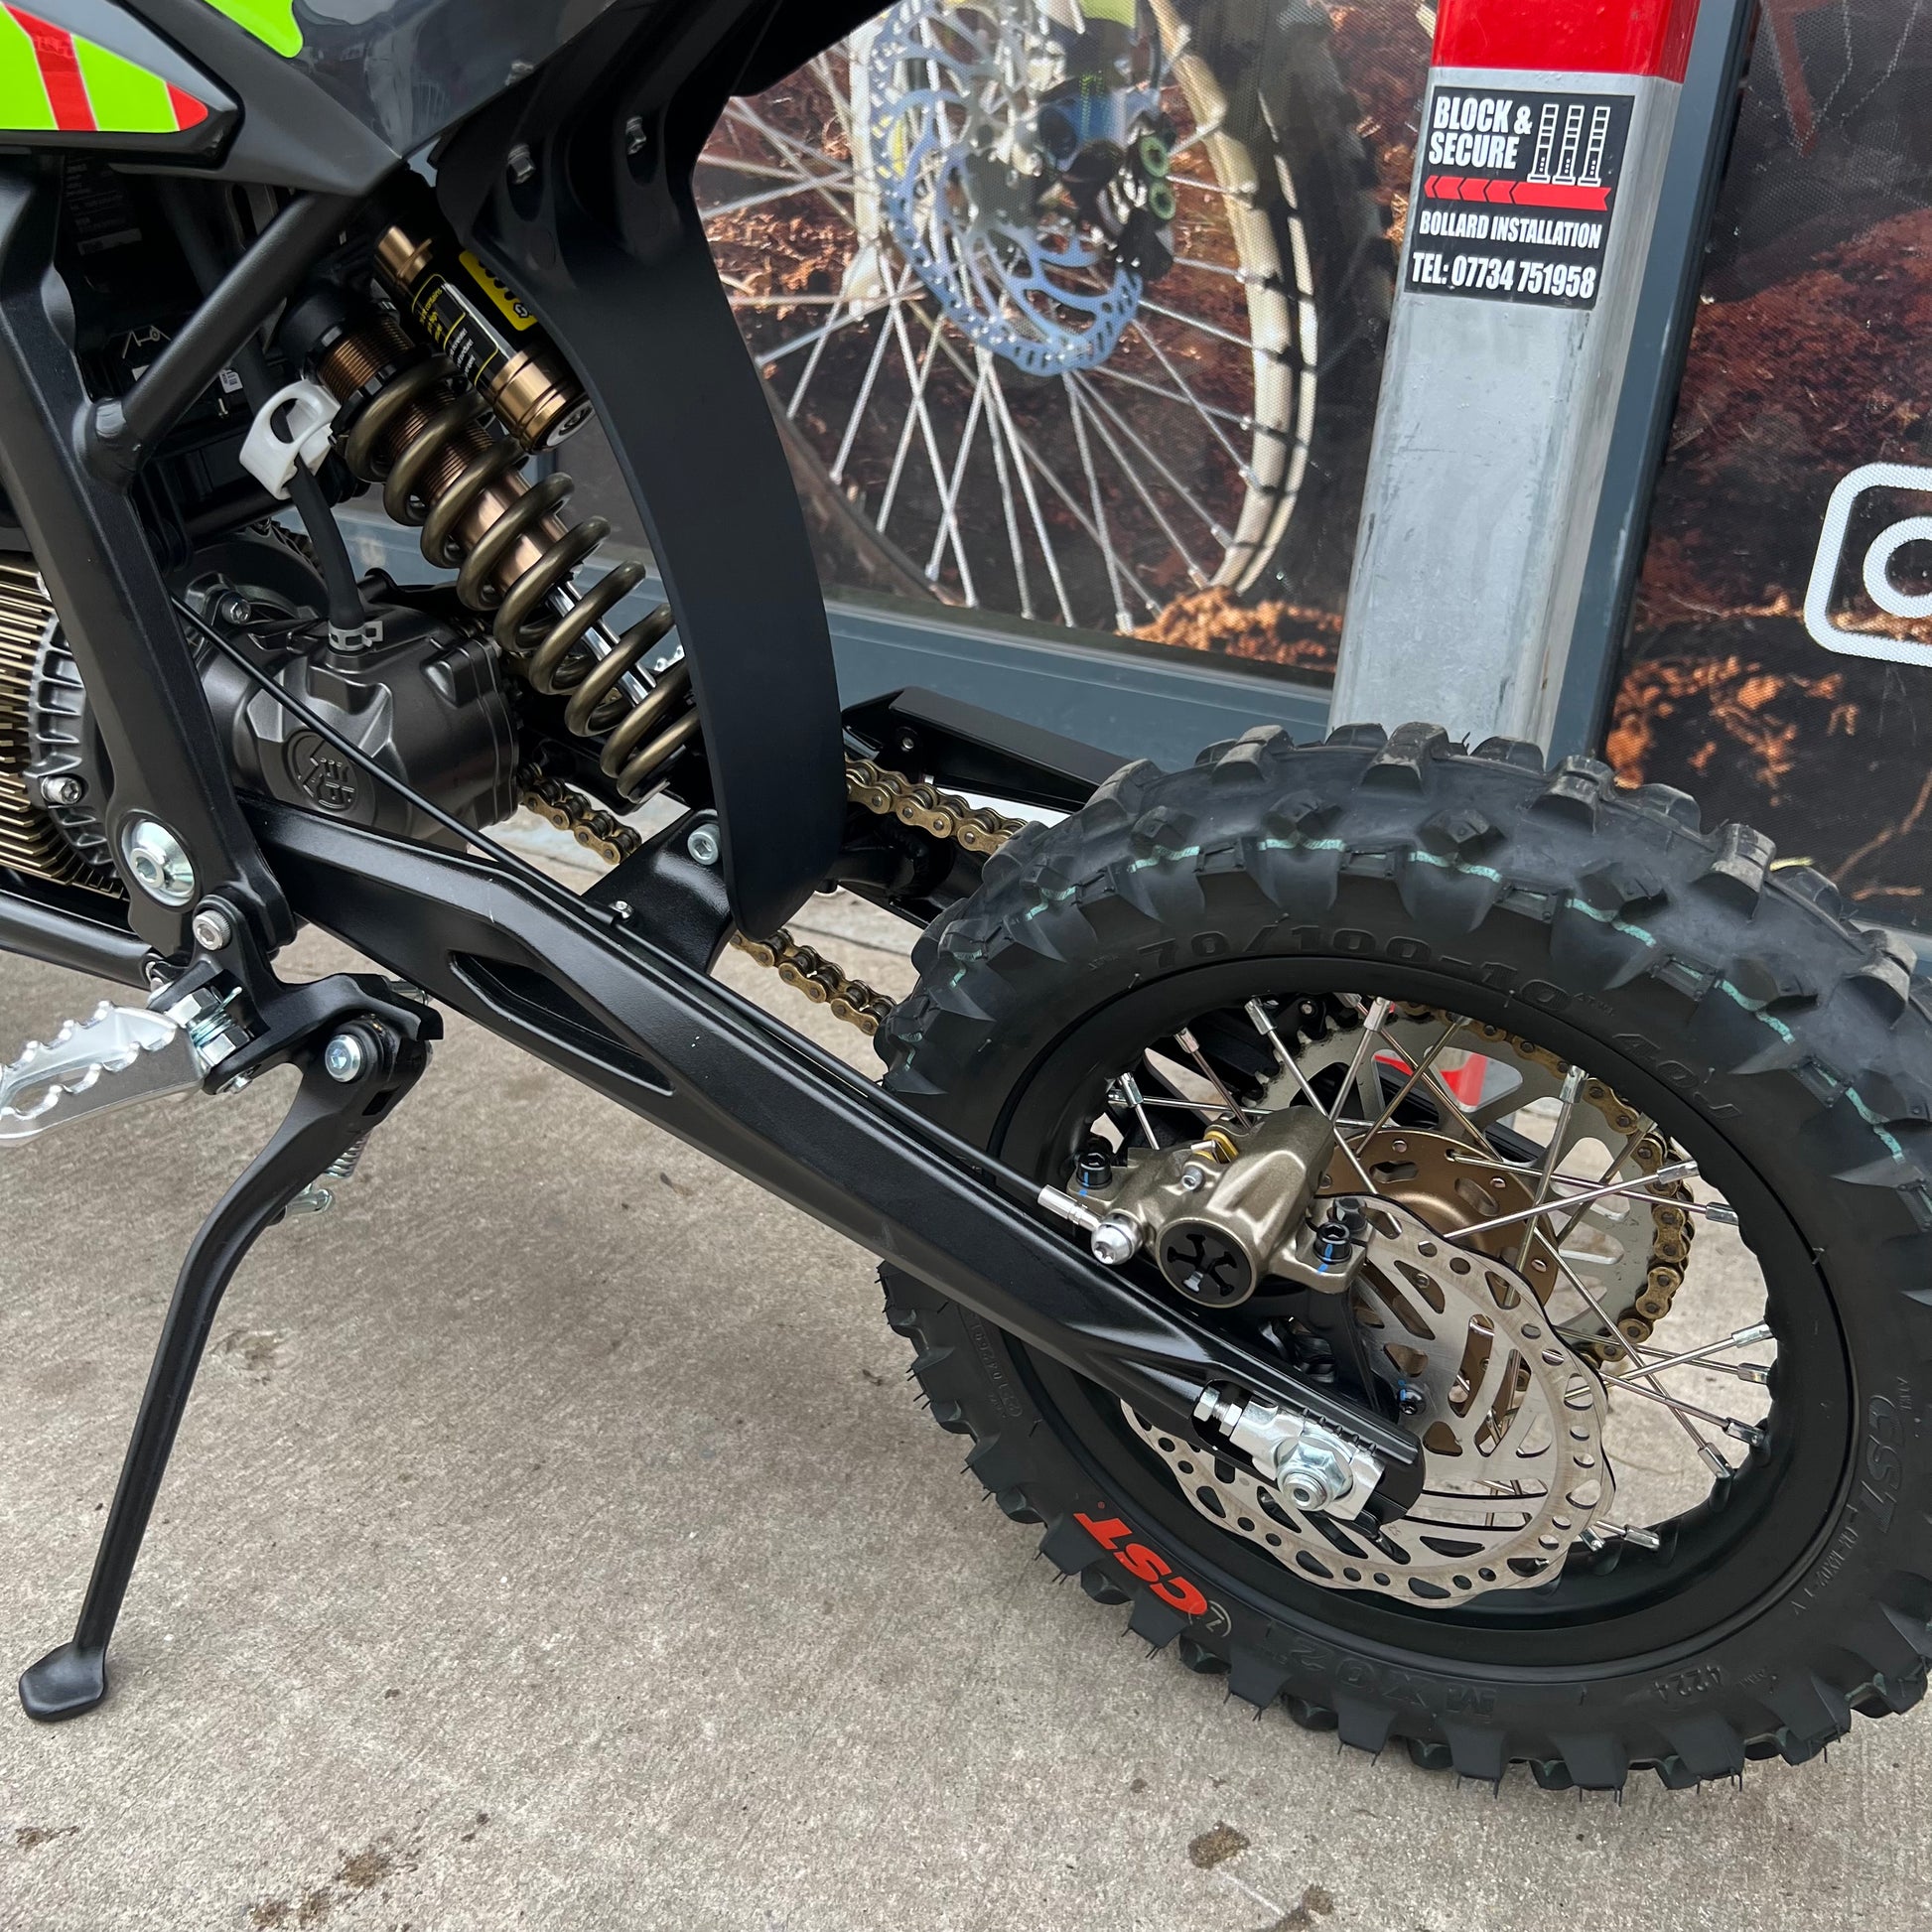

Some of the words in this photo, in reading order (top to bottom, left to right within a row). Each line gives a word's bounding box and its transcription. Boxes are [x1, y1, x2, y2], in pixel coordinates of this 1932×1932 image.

[1433, 96, 1513, 133] BLOCK
[1513, 105, 1533, 135] &
[1428, 131, 1520, 170] SECURE
[1419, 209, 1490, 240] BOLLARD
[1489, 216, 1602, 248] INSTALLATION
[1412, 251, 1449, 285] TEL:
[1450, 255, 1516, 291] 07734
[1517, 261, 1596, 299] 751958
[1073, 1512, 1208, 1615] CST
